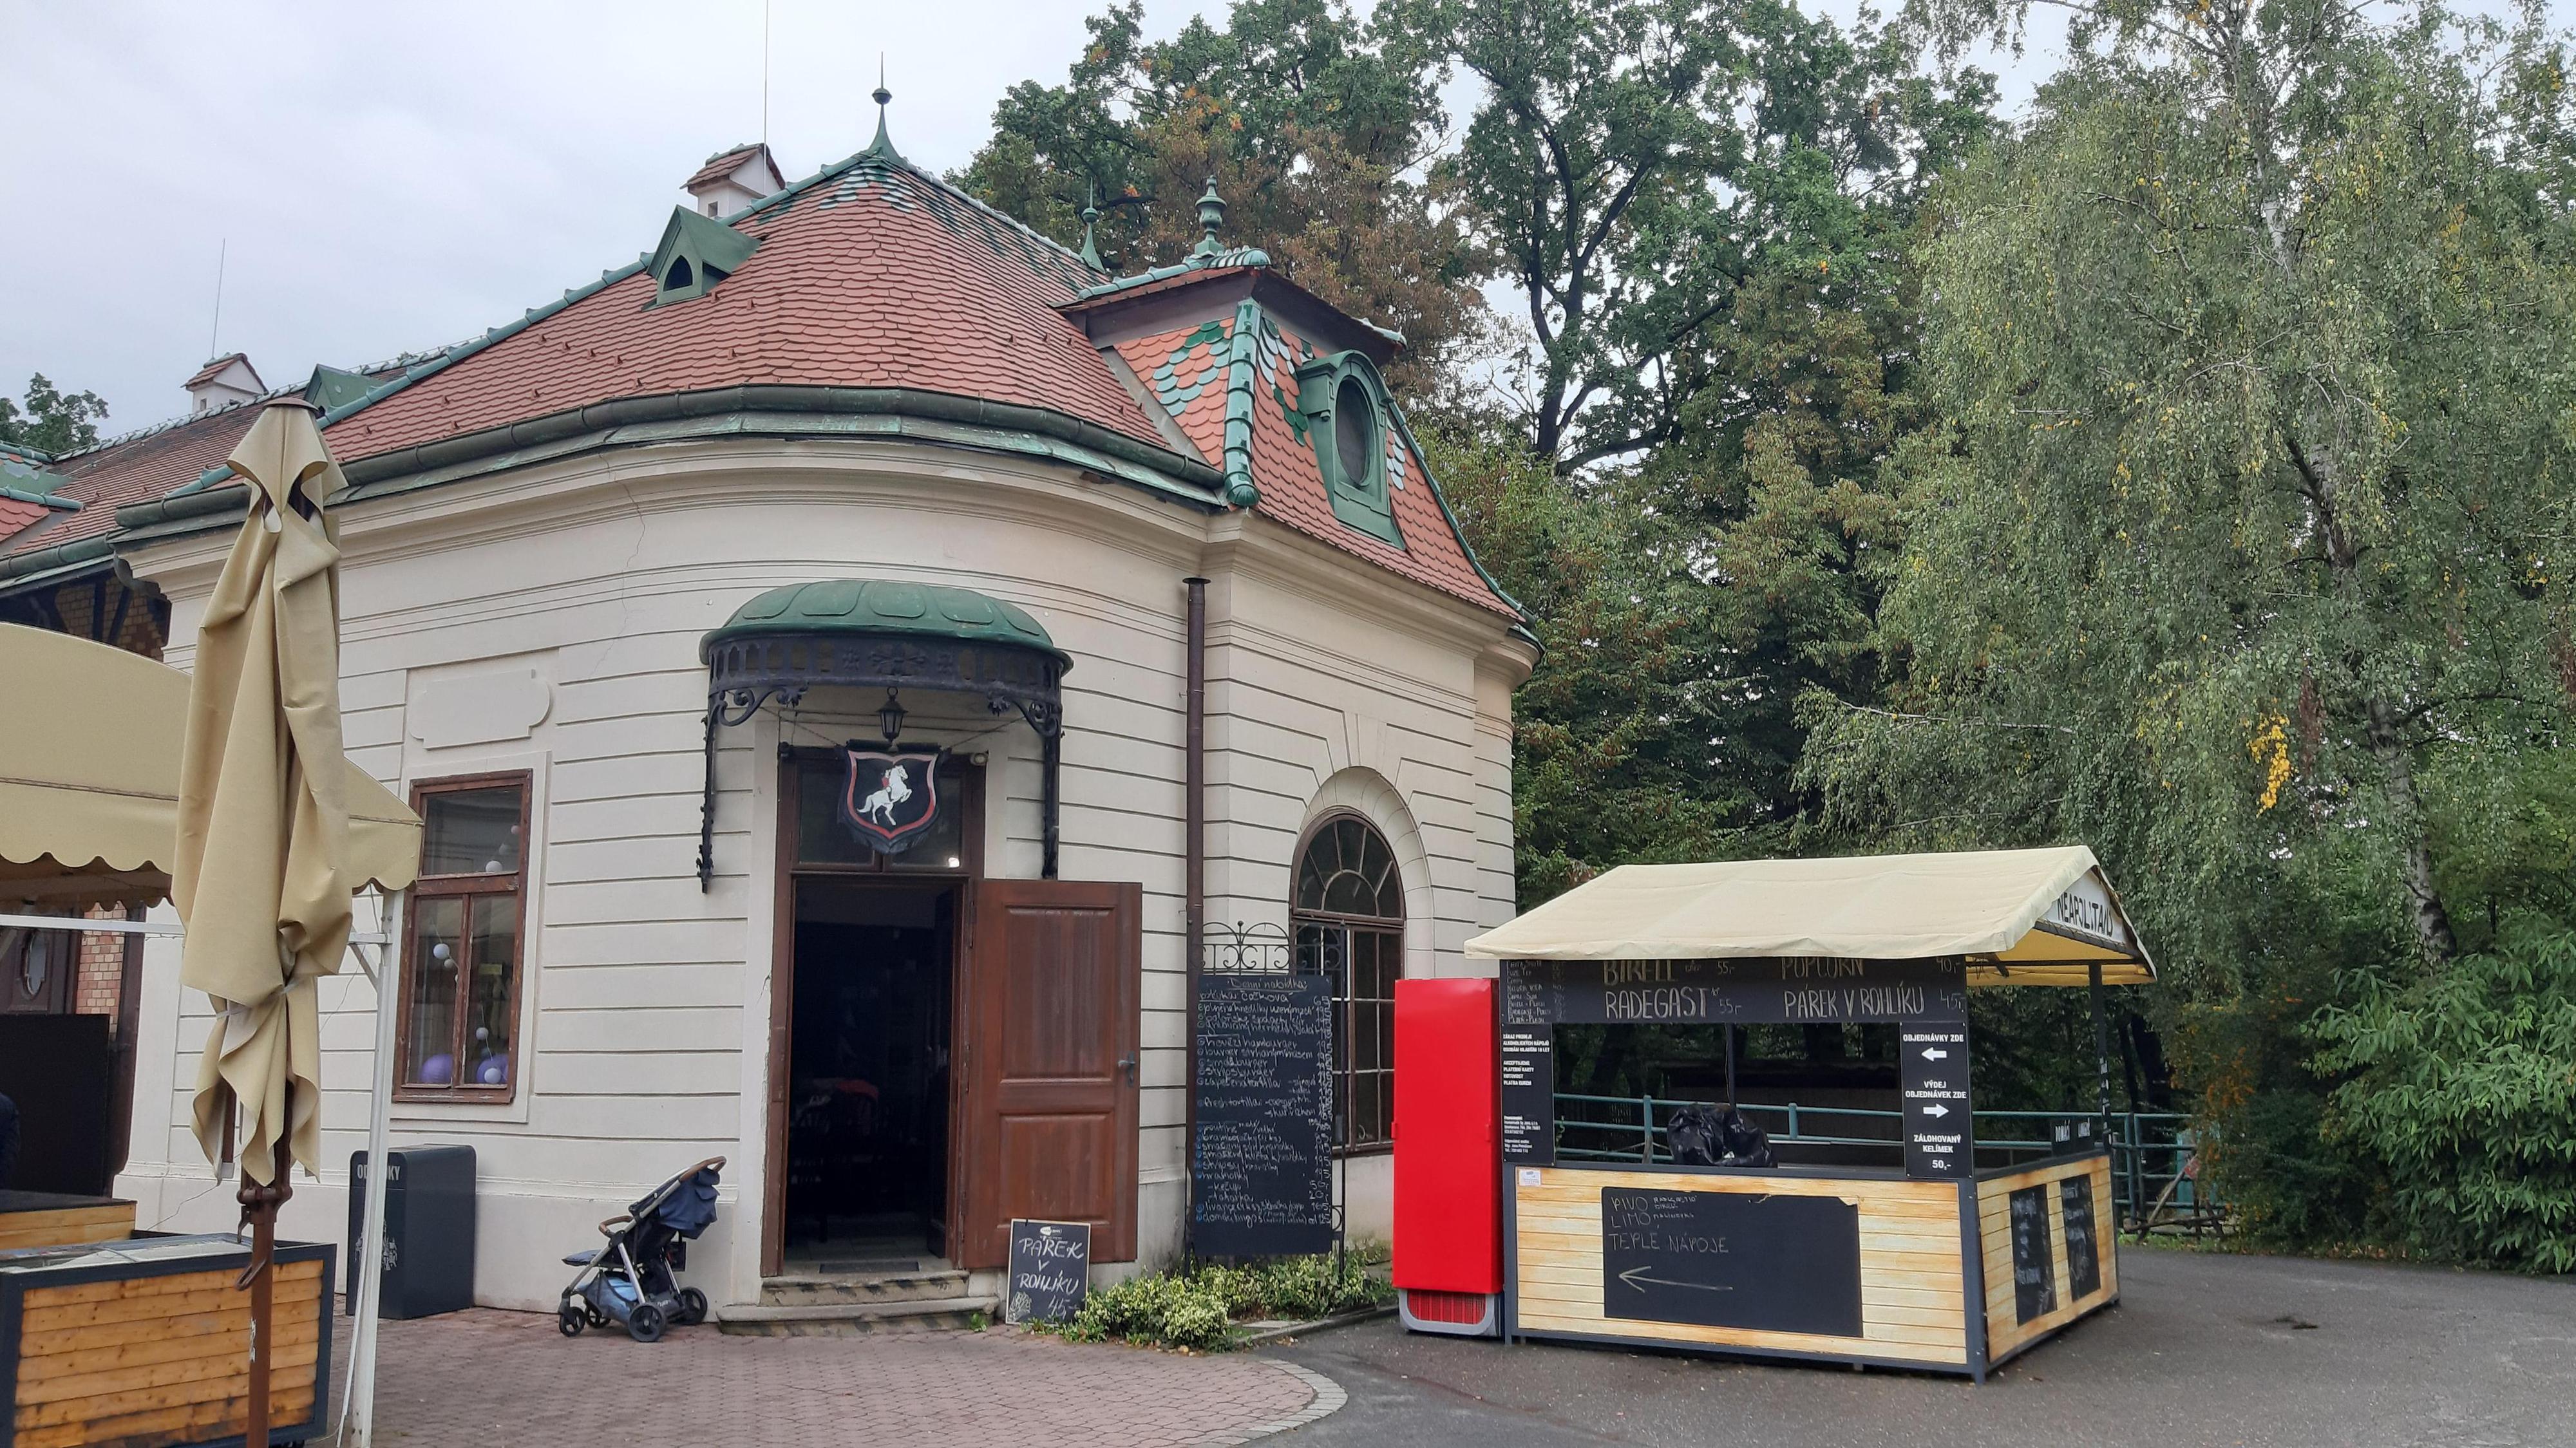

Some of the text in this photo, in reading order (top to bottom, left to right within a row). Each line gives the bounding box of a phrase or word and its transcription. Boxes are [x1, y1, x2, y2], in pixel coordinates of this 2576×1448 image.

[1605, 986, 1709, 1020] RADEGAST
[1784, 983, 1838, 1019] PÁREK
[1844, 989, 1855, 1017] V
[1860, 980, 1924, 1015] ROHLÍKU
[1903, 1033, 1964, 1042] OBJEDNÁVKY ZDE
[1924, 1080, 1947, 1089] VÝDEJ
[1905, 1089, 1952, 1098] OBJEDNÁVEK
[1913, 1133, 1962, 1143] ZÁLOHOVANÝ
[1922, 1144, 1954, 1154] KELÍMEK
[1611, 1196, 1649, 1212] PIVO
[1611, 1212, 1651, 1228] LIMO
[1609, 1224, 1729, 1253] TEPLÉ NÁPOJE
